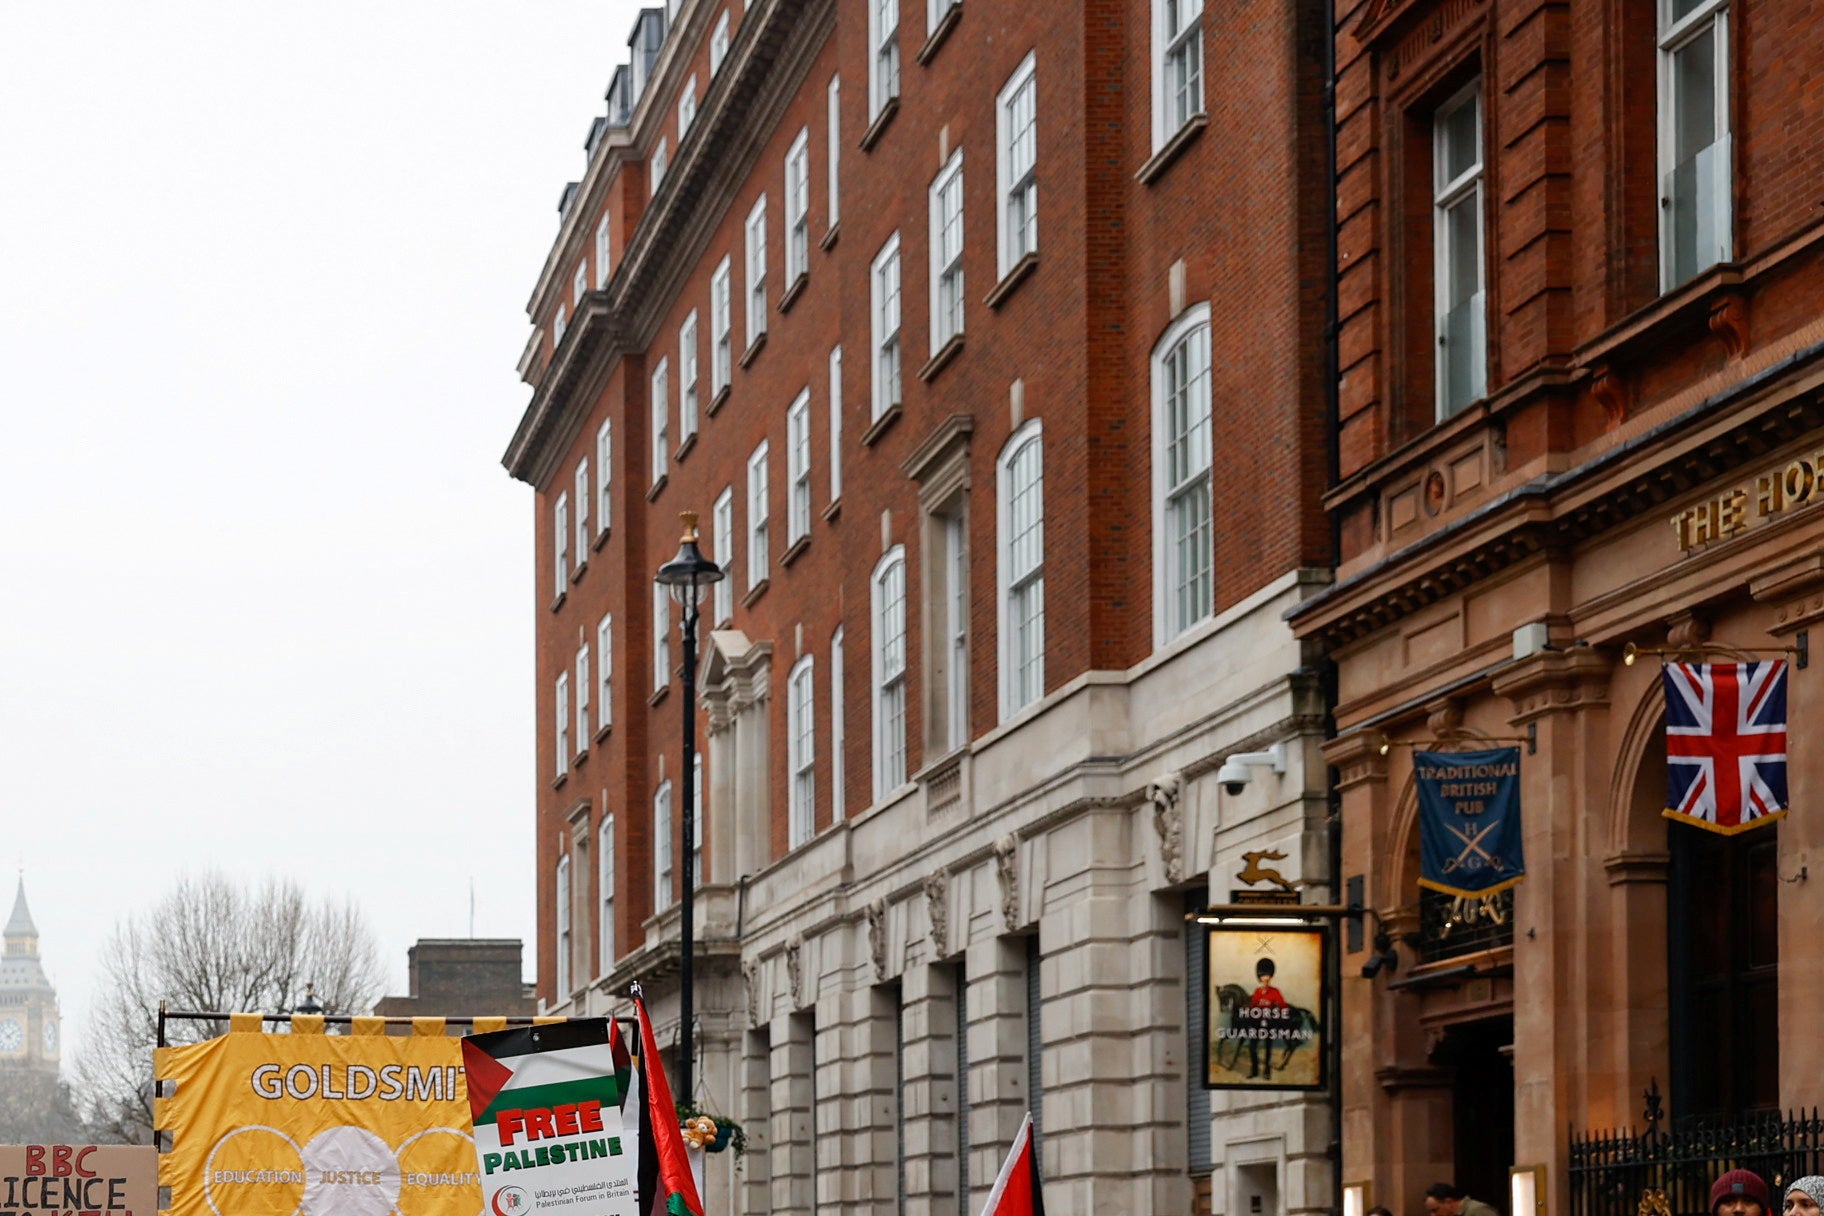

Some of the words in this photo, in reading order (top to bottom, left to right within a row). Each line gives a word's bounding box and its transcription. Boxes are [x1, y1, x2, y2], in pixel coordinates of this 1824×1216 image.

[1670, 490, 1747, 552] THE
[1418, 762, 1517, 780] TRADITIONAL
[1440, 782, 1497, 797] BRITISH
[1454, 800, 1485, 815] PUB
[1464, 822, 1478, 836] H
[1468, 855, 1482, 869] G
[1238, 1007, 1290, 1019] HORSE
[1216, 1027, 1313, 1040] GUARDSMAN
[496, 1100, 604, 1147] FREE
[26, 1145, 98, 1177] BBC
[483, 1136, 623, 1175] PALESTINE
[214, 1170, 302, 1184] EDUCATION
[319, 1171, 382, 1185] JUSTICE
[536, 1197, 574, 1209] Palestinian
[575, 1193, 597, 1203] Forum
[606, 1189, 630, 1199] Britain
